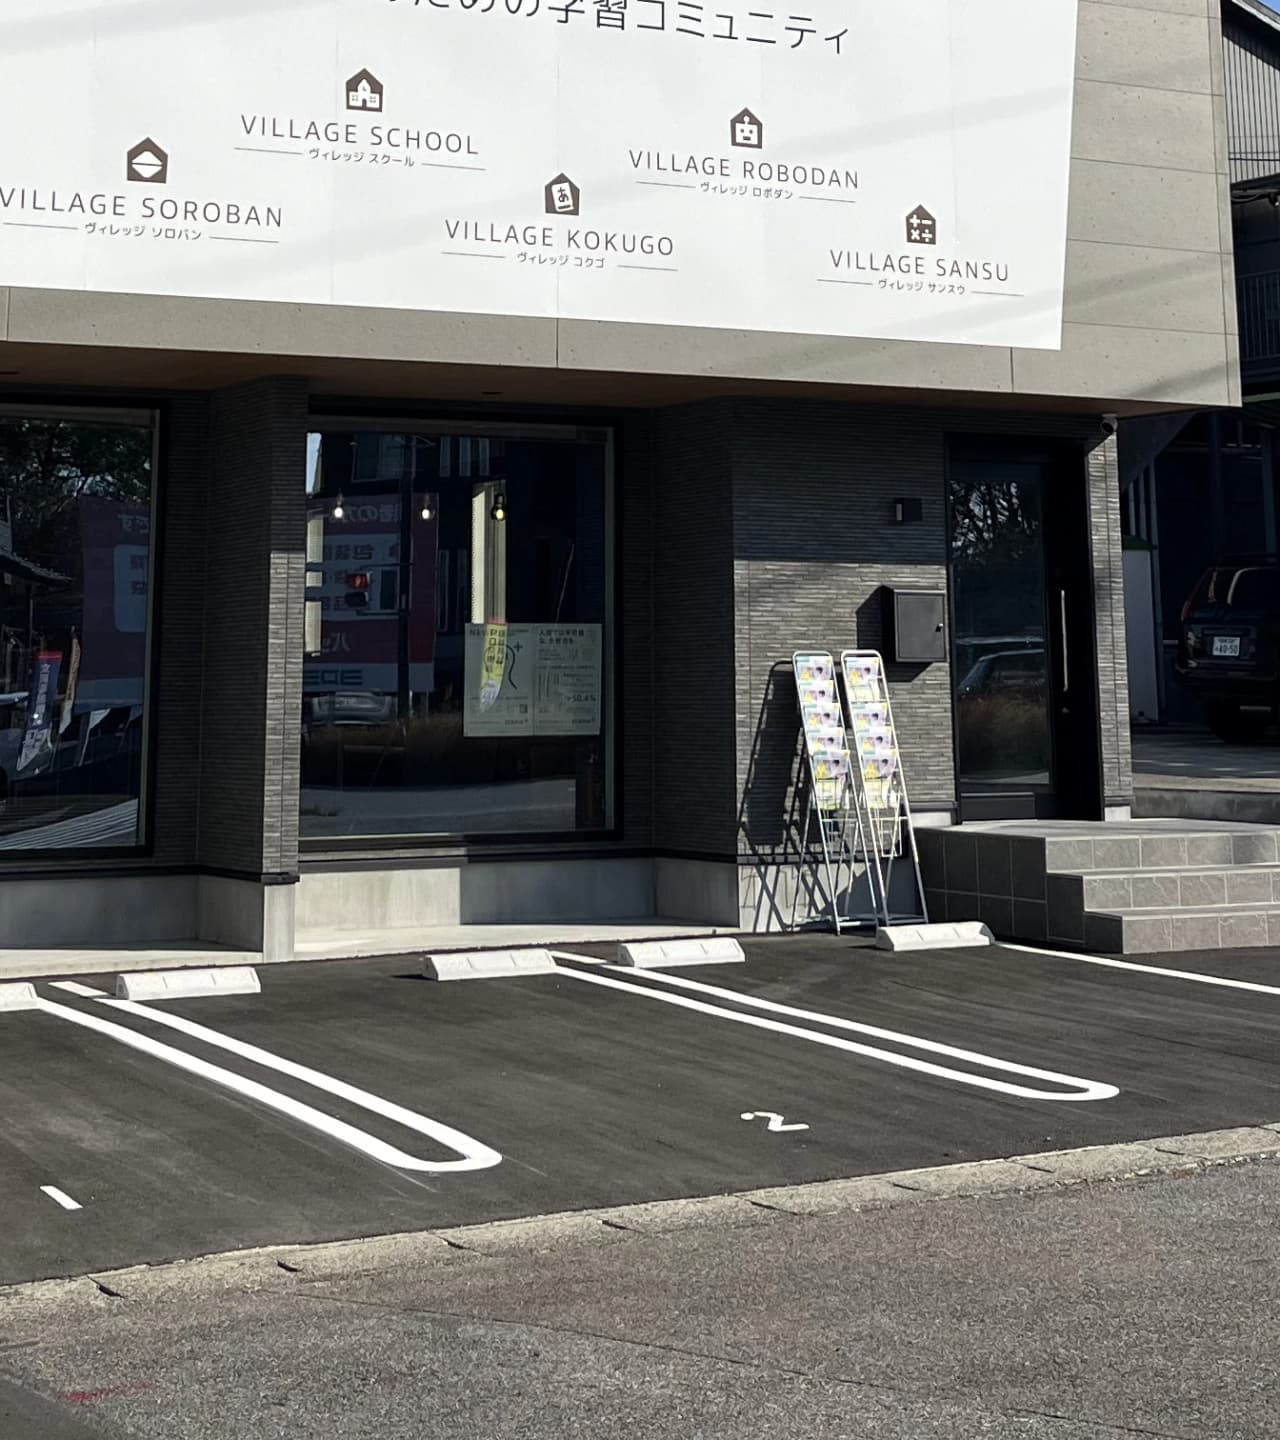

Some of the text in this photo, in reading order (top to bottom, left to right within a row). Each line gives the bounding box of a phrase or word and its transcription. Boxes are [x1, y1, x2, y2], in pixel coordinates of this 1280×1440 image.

[240, 114, 479, 155] VILLAGE SCHOOL
[308, 148, 415, 168] ヴィレッジ スクール
[628, 149, 858, 190] VILLAGE ROBODAN
[700, 181, 748, 196] ヴィレッジ
[141, 197, 282, 228] SOROBAN
[84, 222, 202, 241] ヴィレッジ ソロバン
[444, 219, 674, 257] VILLAGE KOKUGO
[517, 251, 605, 269] ヴィレッジ コクゴ
[829, 249, 1009, 282] VILLAGE SANSU
[878, 278, 924, 292] ヴィレッジ
[740, 1111, 810, 1131] 2
